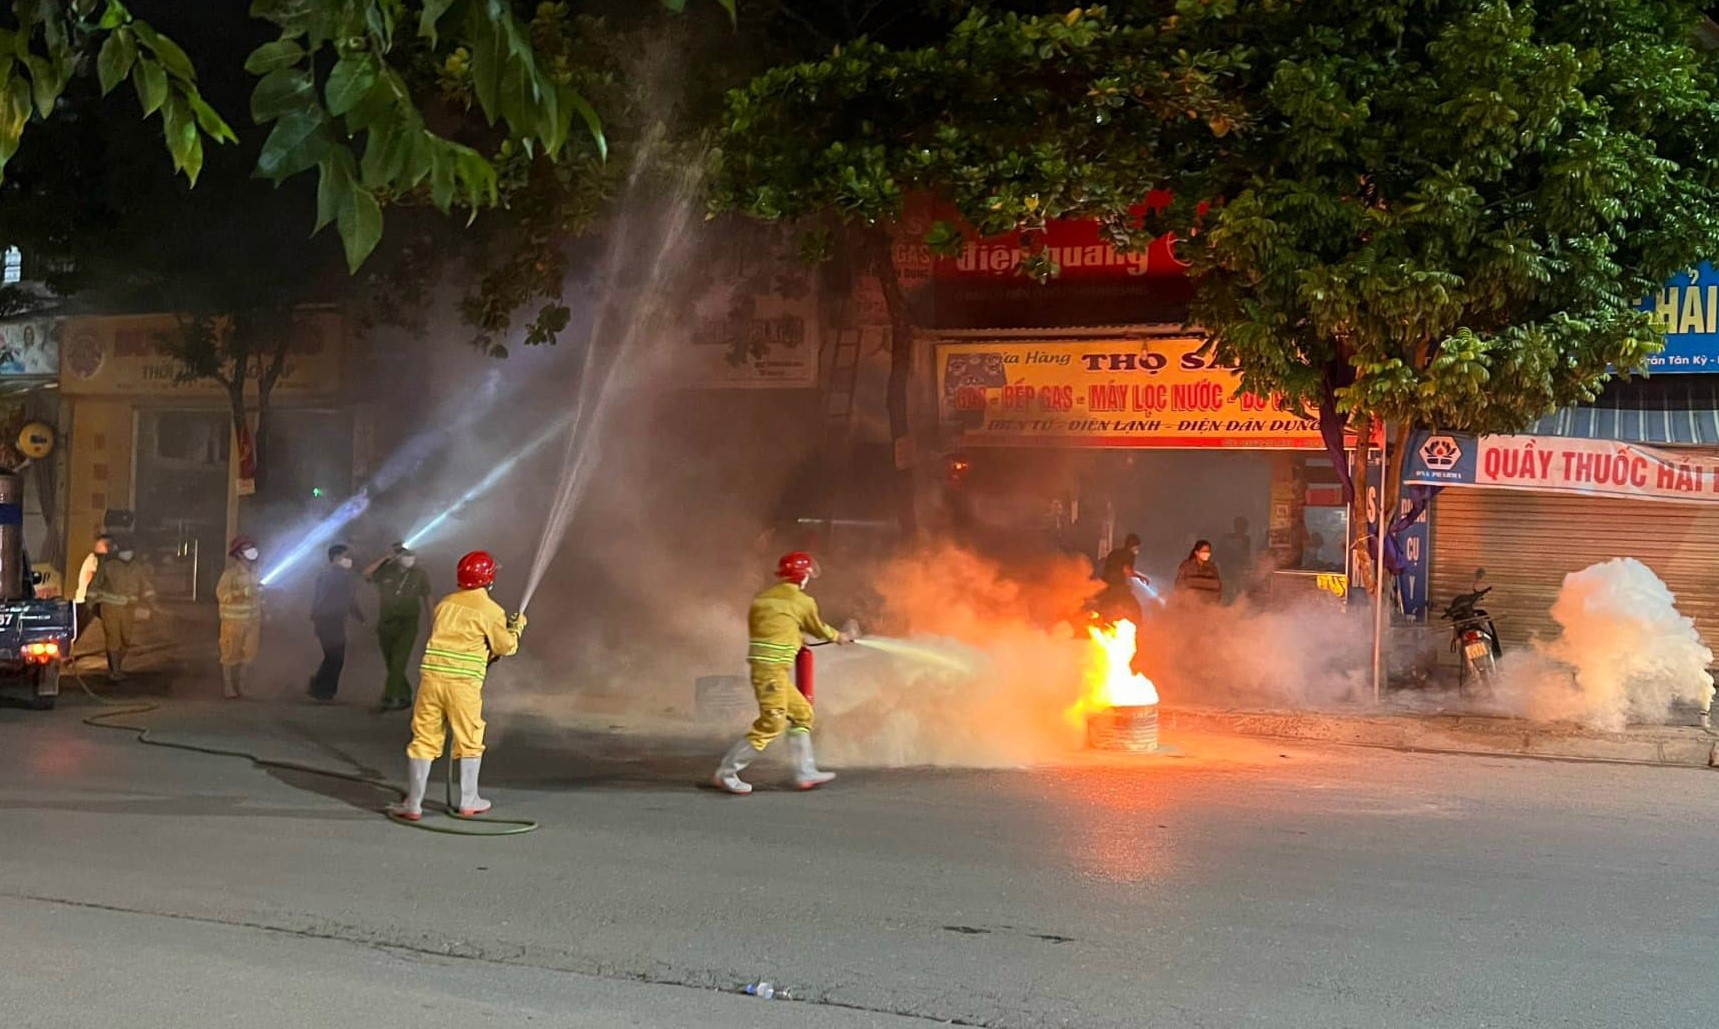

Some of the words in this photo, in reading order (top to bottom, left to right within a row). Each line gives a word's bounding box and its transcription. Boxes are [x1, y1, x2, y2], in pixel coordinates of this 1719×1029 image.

[1656, 269, 1718, 334] HẢI
[1025, 350, 1072, 366] Hàng
[1081, 353, 1168, 375] THỌ
[1668, 355, 1690, 365] Tân
[1003, 377, 1036, 412] BẾP
[1039, 385, 1073, 413] GAS
[1089, 379, 1128, 412] MÁY
[1132, 384, 1167, 418] LỌC
[1171, 378, 1223, 412] NƯỚC
[1113, 420, 1161, 434] LẠNH
[1178, 418, 1223, 433] ĐIỆN
[1269, 420, 1320, 434] DỤNG
[1484, 439, 1554, 480] QUẦY
[1562, 443, 1648, 488] THUỐC
[1656, 456, 1703, 492] HẢI
[1406, 537, 1420, 566] CỤ
